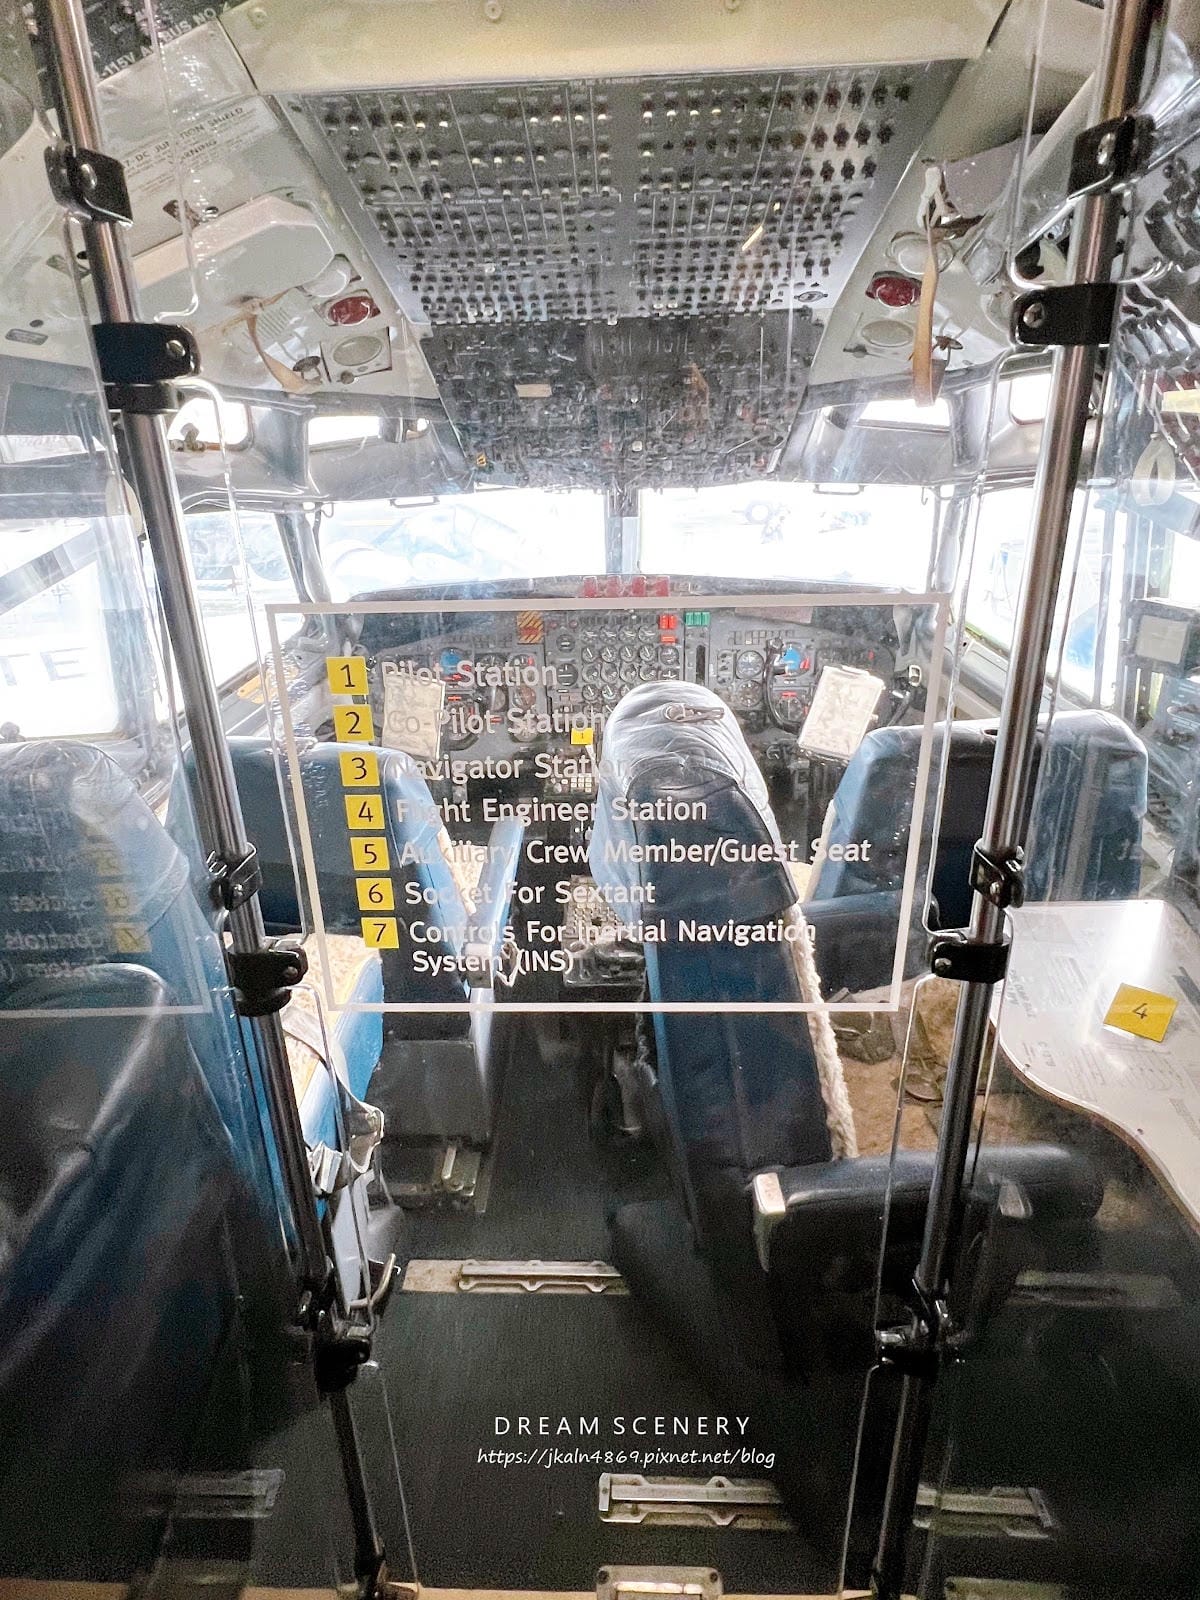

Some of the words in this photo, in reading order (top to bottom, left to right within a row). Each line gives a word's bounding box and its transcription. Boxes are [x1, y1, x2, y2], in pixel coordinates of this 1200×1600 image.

[339, 664, 357, 689] 1
[382, 661, 443, 687] Pilot
[455, 661, 558, 688] Station
[347, 711, 362, 736] 2
[506, 708, 606, 734] Station
[351, 757, 368, 781] 3
[395, 754, 523, 785] Navigator
[358, 801, 374, 823] 4
[482, 796, 598, 828] Engineer
[611, 795, 707, 821] Station
[363, 842, 378, 865] 5
[526, 840, 589, 864] Crew
[603, 836, 799, 866] Member/Guest
[808, 836, 872, 862] Seat
[369, 883, 384, 904] 6
[506, 881, 545, 904] For
[555, 880, 656, 904] Sextant
[372, 923, 388, 942] 7
[527, 920, 567, 943] For
[677, 917, 817, 947] Navigation
[517, 948, 574, 976] (INS)
[1132, 1003, 1148, 1020] 4
